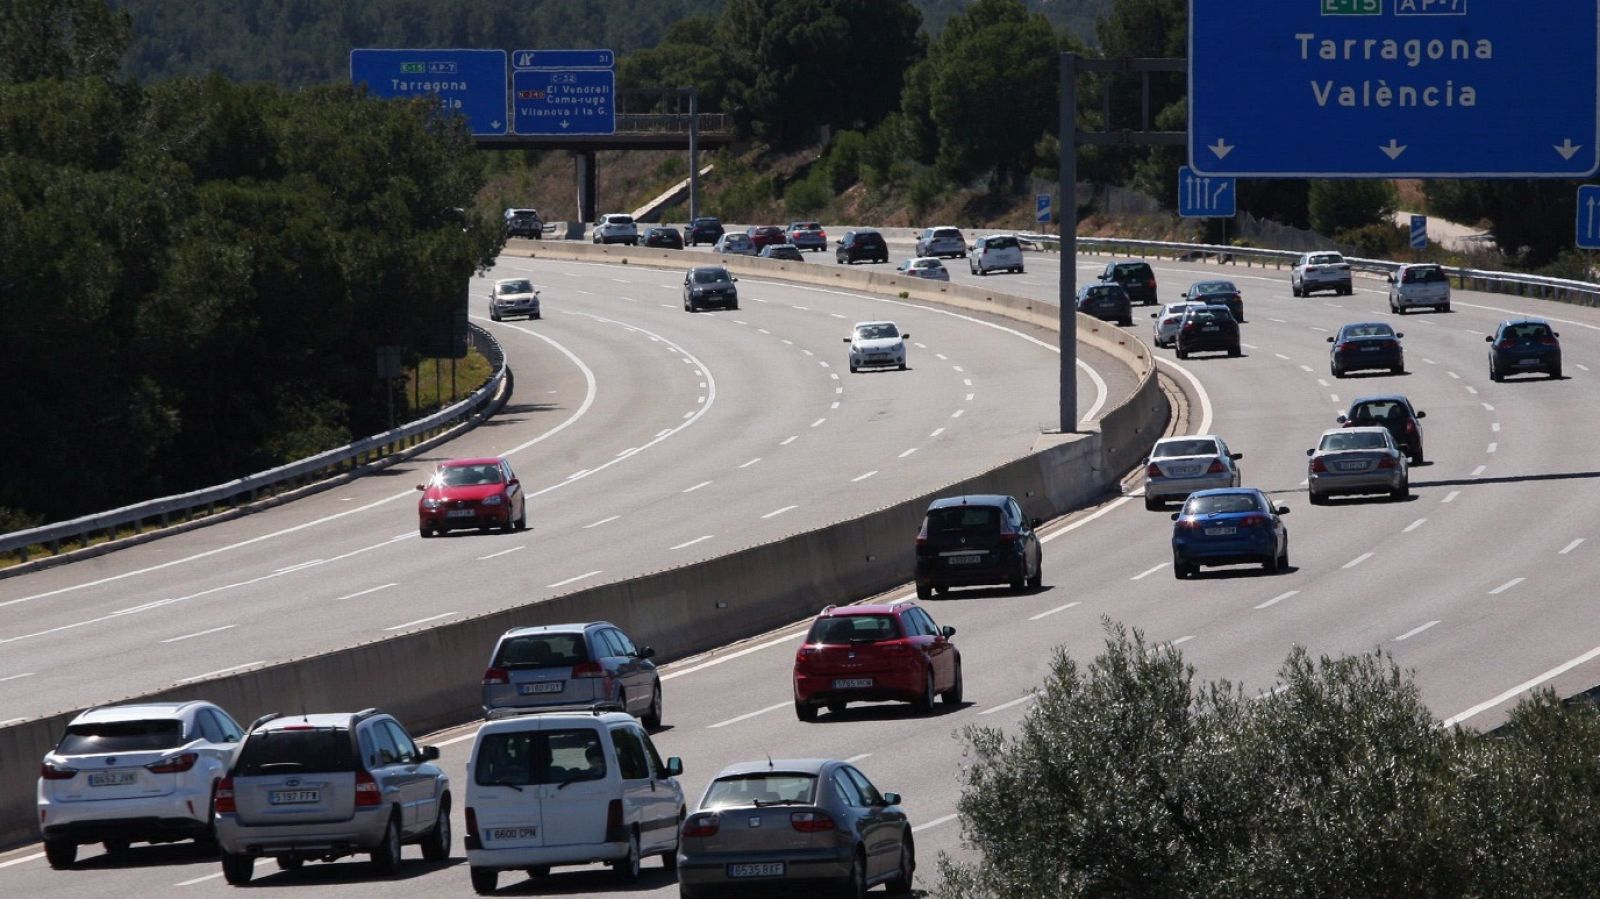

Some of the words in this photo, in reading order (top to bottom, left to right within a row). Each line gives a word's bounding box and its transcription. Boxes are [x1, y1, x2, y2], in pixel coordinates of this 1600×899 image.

[1295, 33, 1492, 67] Tarragona
[402, 64, 423, 72] E-15
[431, 64, 455, 72] AP-7
[552, 74, 575, 82] C-32
[391, 79, 467, 93] Tarragona
[546, 85, 557, 94] El
[562, 85, 609, 94] Vendrell
[1311, 79, 1476, 107] València
[546, 95, 606, 105] Coma-ruga
[521, 107, 570, 116] Vilanova
[583, 107, 593, 115] la
[597, 106, 608, 115] G.
[494, 829, 517, 840] 6600
[519, 828, 536, 838] CPN
[736, 864, 761, 876] 6535
